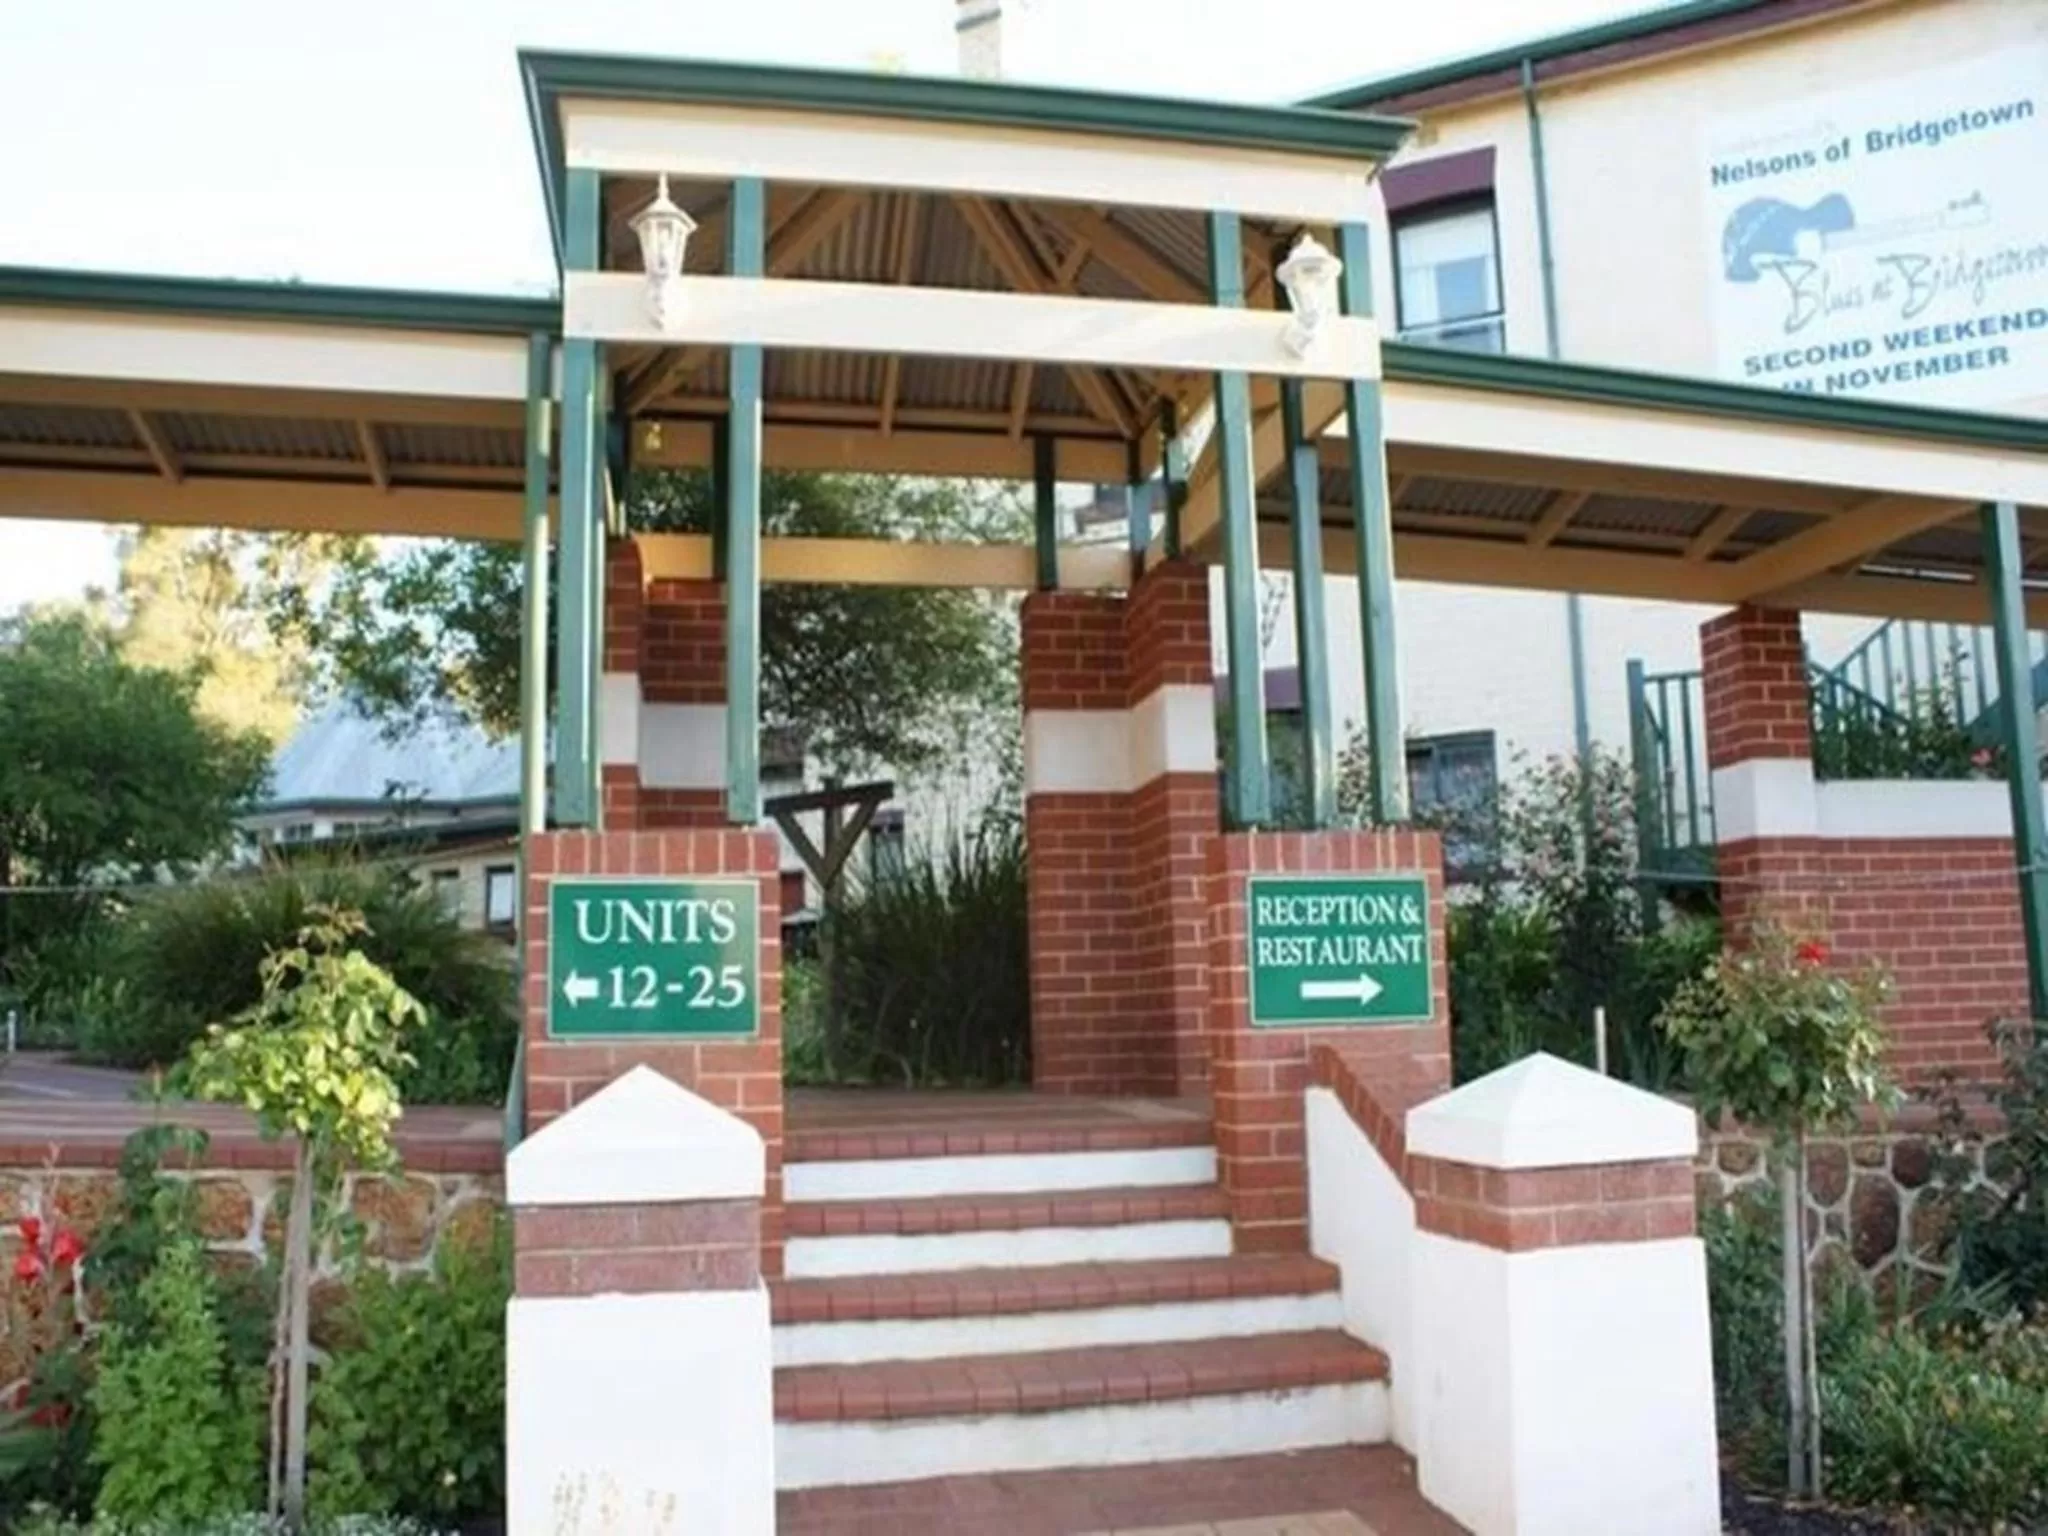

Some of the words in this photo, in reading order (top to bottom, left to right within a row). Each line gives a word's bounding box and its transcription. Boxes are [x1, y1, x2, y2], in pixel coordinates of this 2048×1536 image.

[1710, 147, 1818, 188] Nelsons
[1825, 137, 1852, 163] of
[1865, 97, 2035, 154] Bridgetown
[1744, 338, 1873, 377] SECOND
[1882, 307, 2048, 352] WEEKEND
[1825, 345, 2012, 395] NOVEMBER
[573, 898, 737, 945] UNITS
[1256, 933, 1424, 967] RESTAURANT
[607, 964, 747, 1010] 12-25
